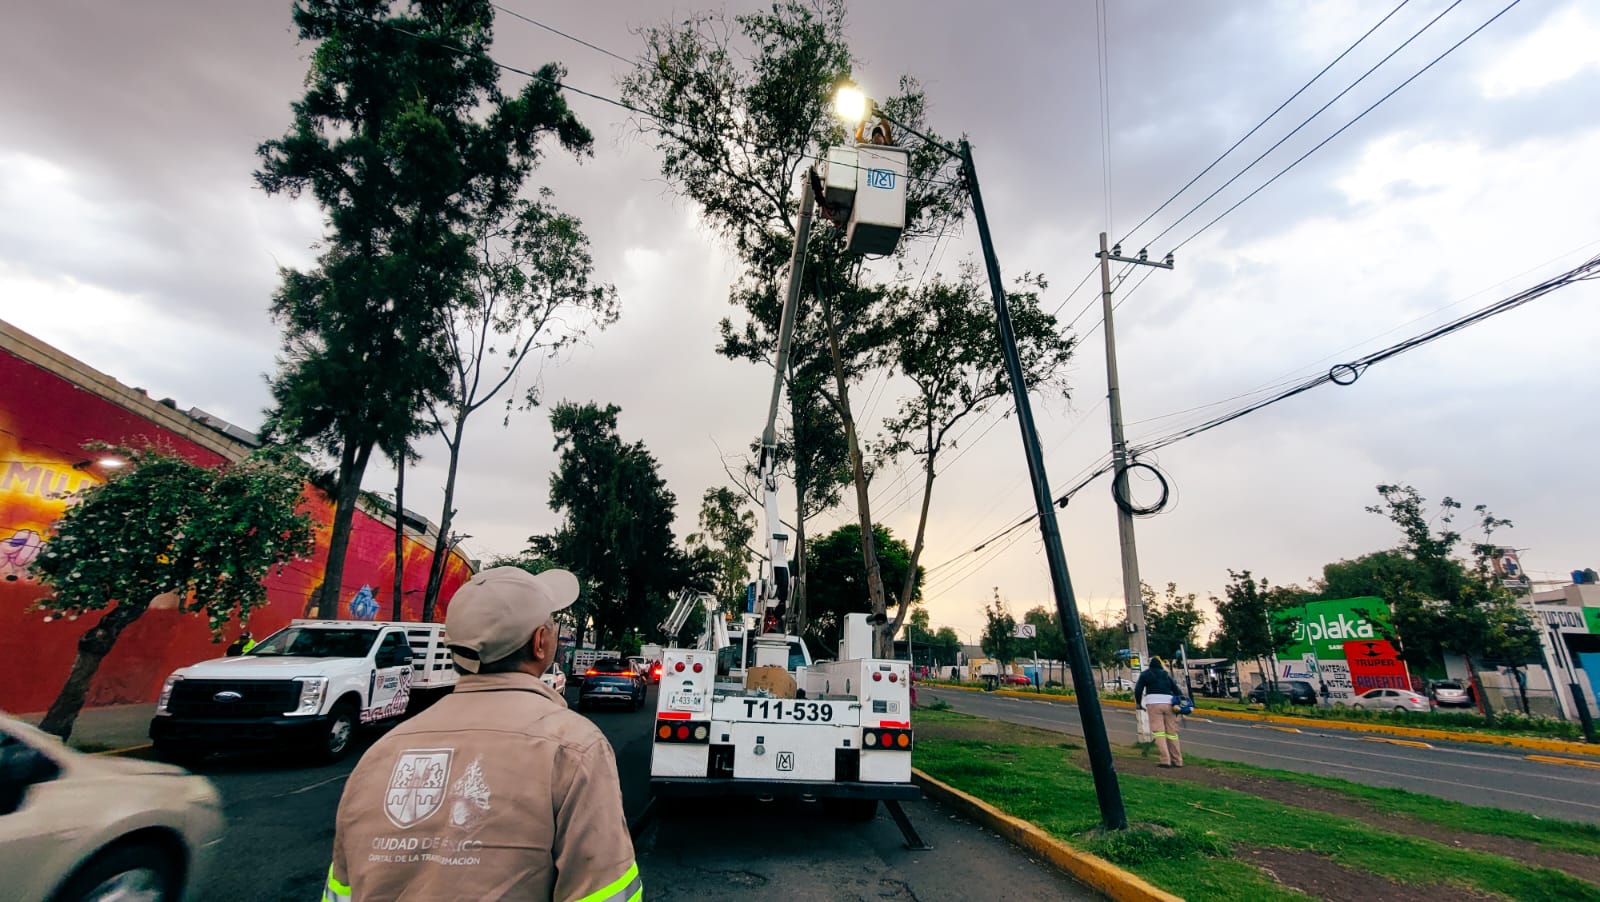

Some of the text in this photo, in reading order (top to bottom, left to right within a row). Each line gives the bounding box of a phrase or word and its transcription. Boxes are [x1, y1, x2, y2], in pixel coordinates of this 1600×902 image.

[1538, 611, 1584, 628] UCCION
[1307, 614, 1374, 646] plaka
[1357, 675, 1405, 688] ABIERTO
[743, 700, 832, 722] T11-539
[371, 837, 418, 850] CIUDAD
[395, 854, 406, 862] DE
[408, 854, 419, 862] LA
